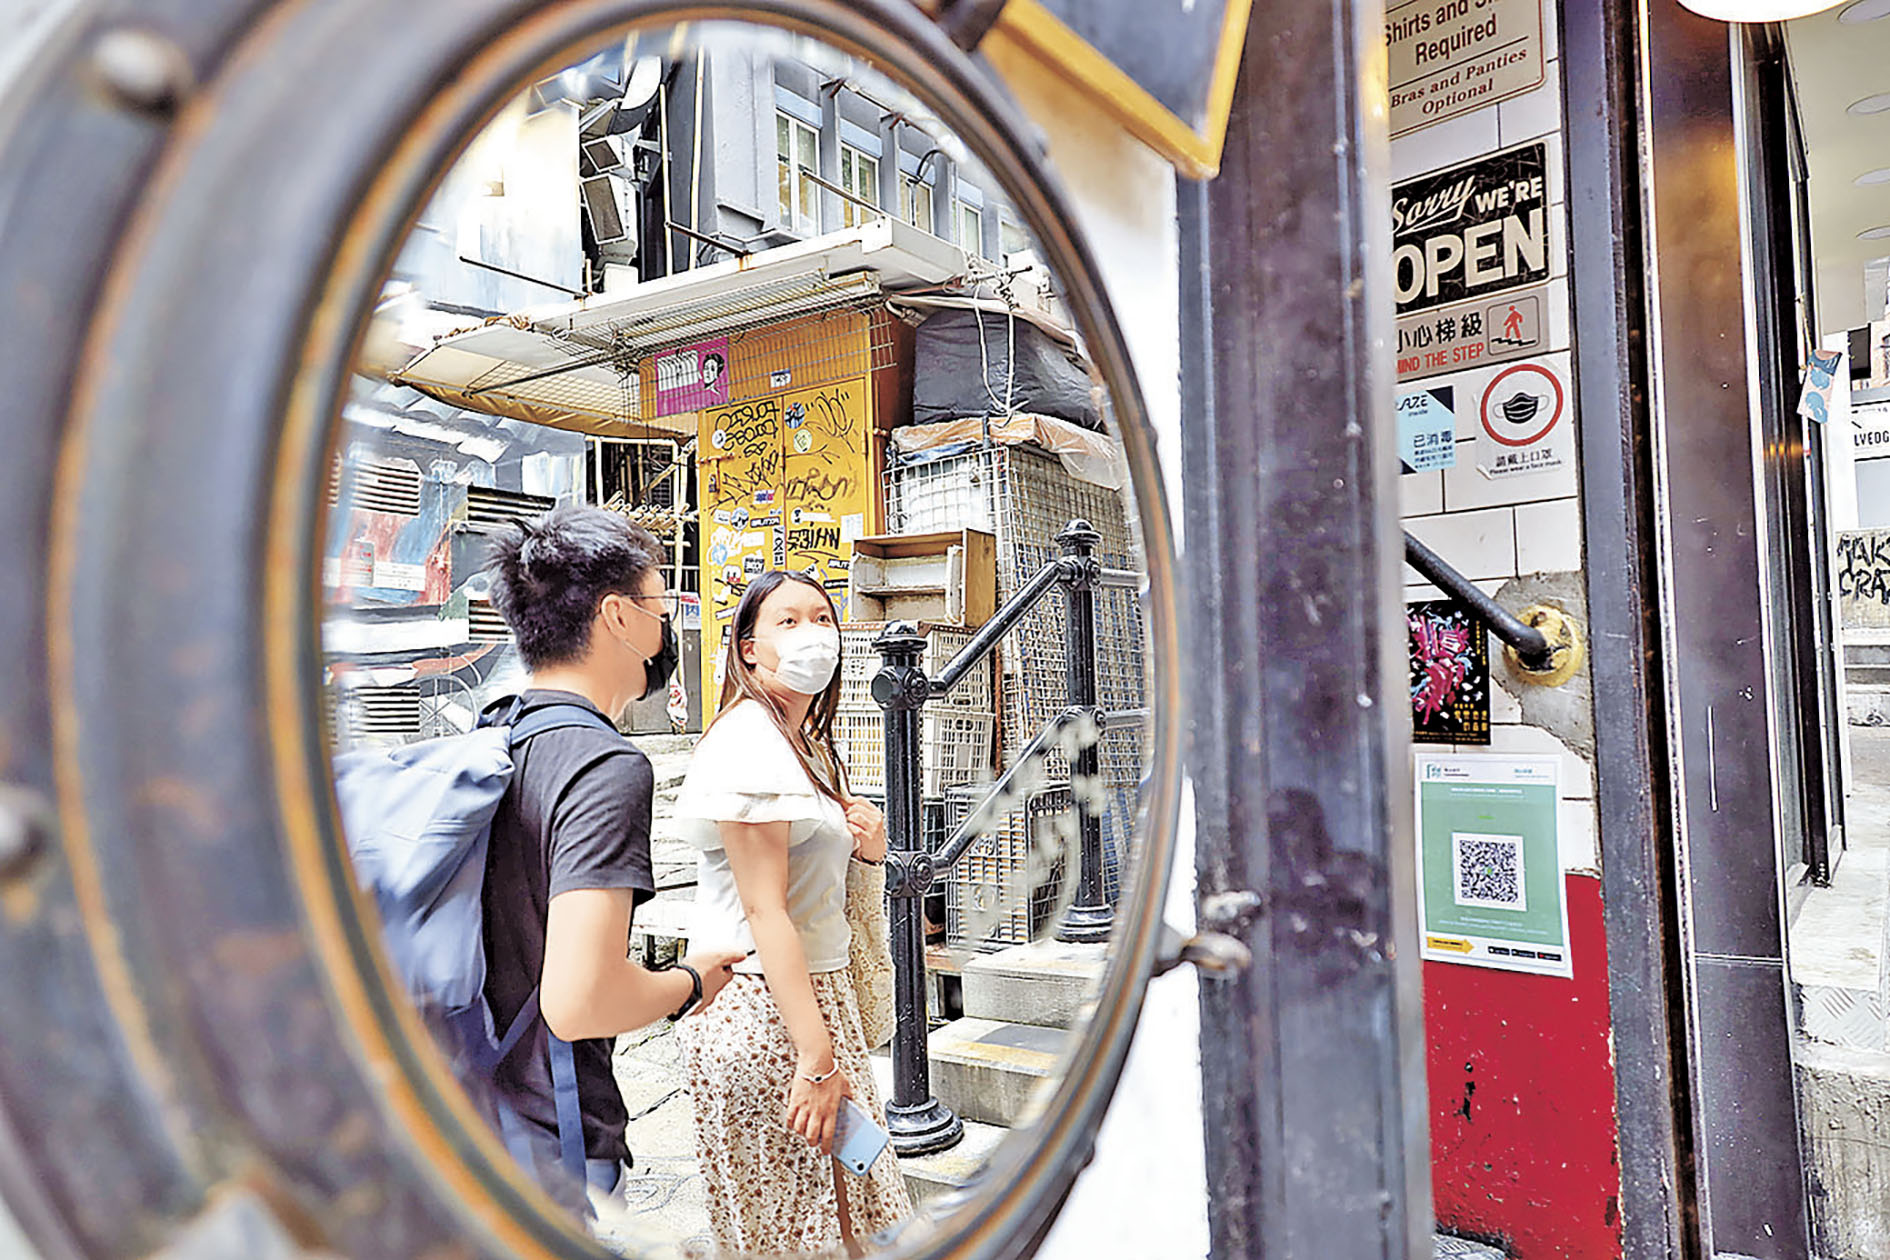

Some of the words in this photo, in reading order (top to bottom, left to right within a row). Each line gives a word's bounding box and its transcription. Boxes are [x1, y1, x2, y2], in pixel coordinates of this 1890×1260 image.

[1436, 0, 1469, 25] and
[1415, 13, 1497, 65] Required
[1391, 87, 1425, 108] Bras
[1430, 71, 1460, 93] and
[1466, 49, 1527, 80] Panties
[1422, 78, 1494, 114] Optional
[1392, 175, 1478, 238] Sorry
[1475, 176, 1543, 213] WE'RE
[1393, 208, 1546, 304] OPEN
[1397, 312, 1483, 353] 小心梯級
[1425, 350, 1448, 368] THE
[1453, 342, 1485, 363] STEP
